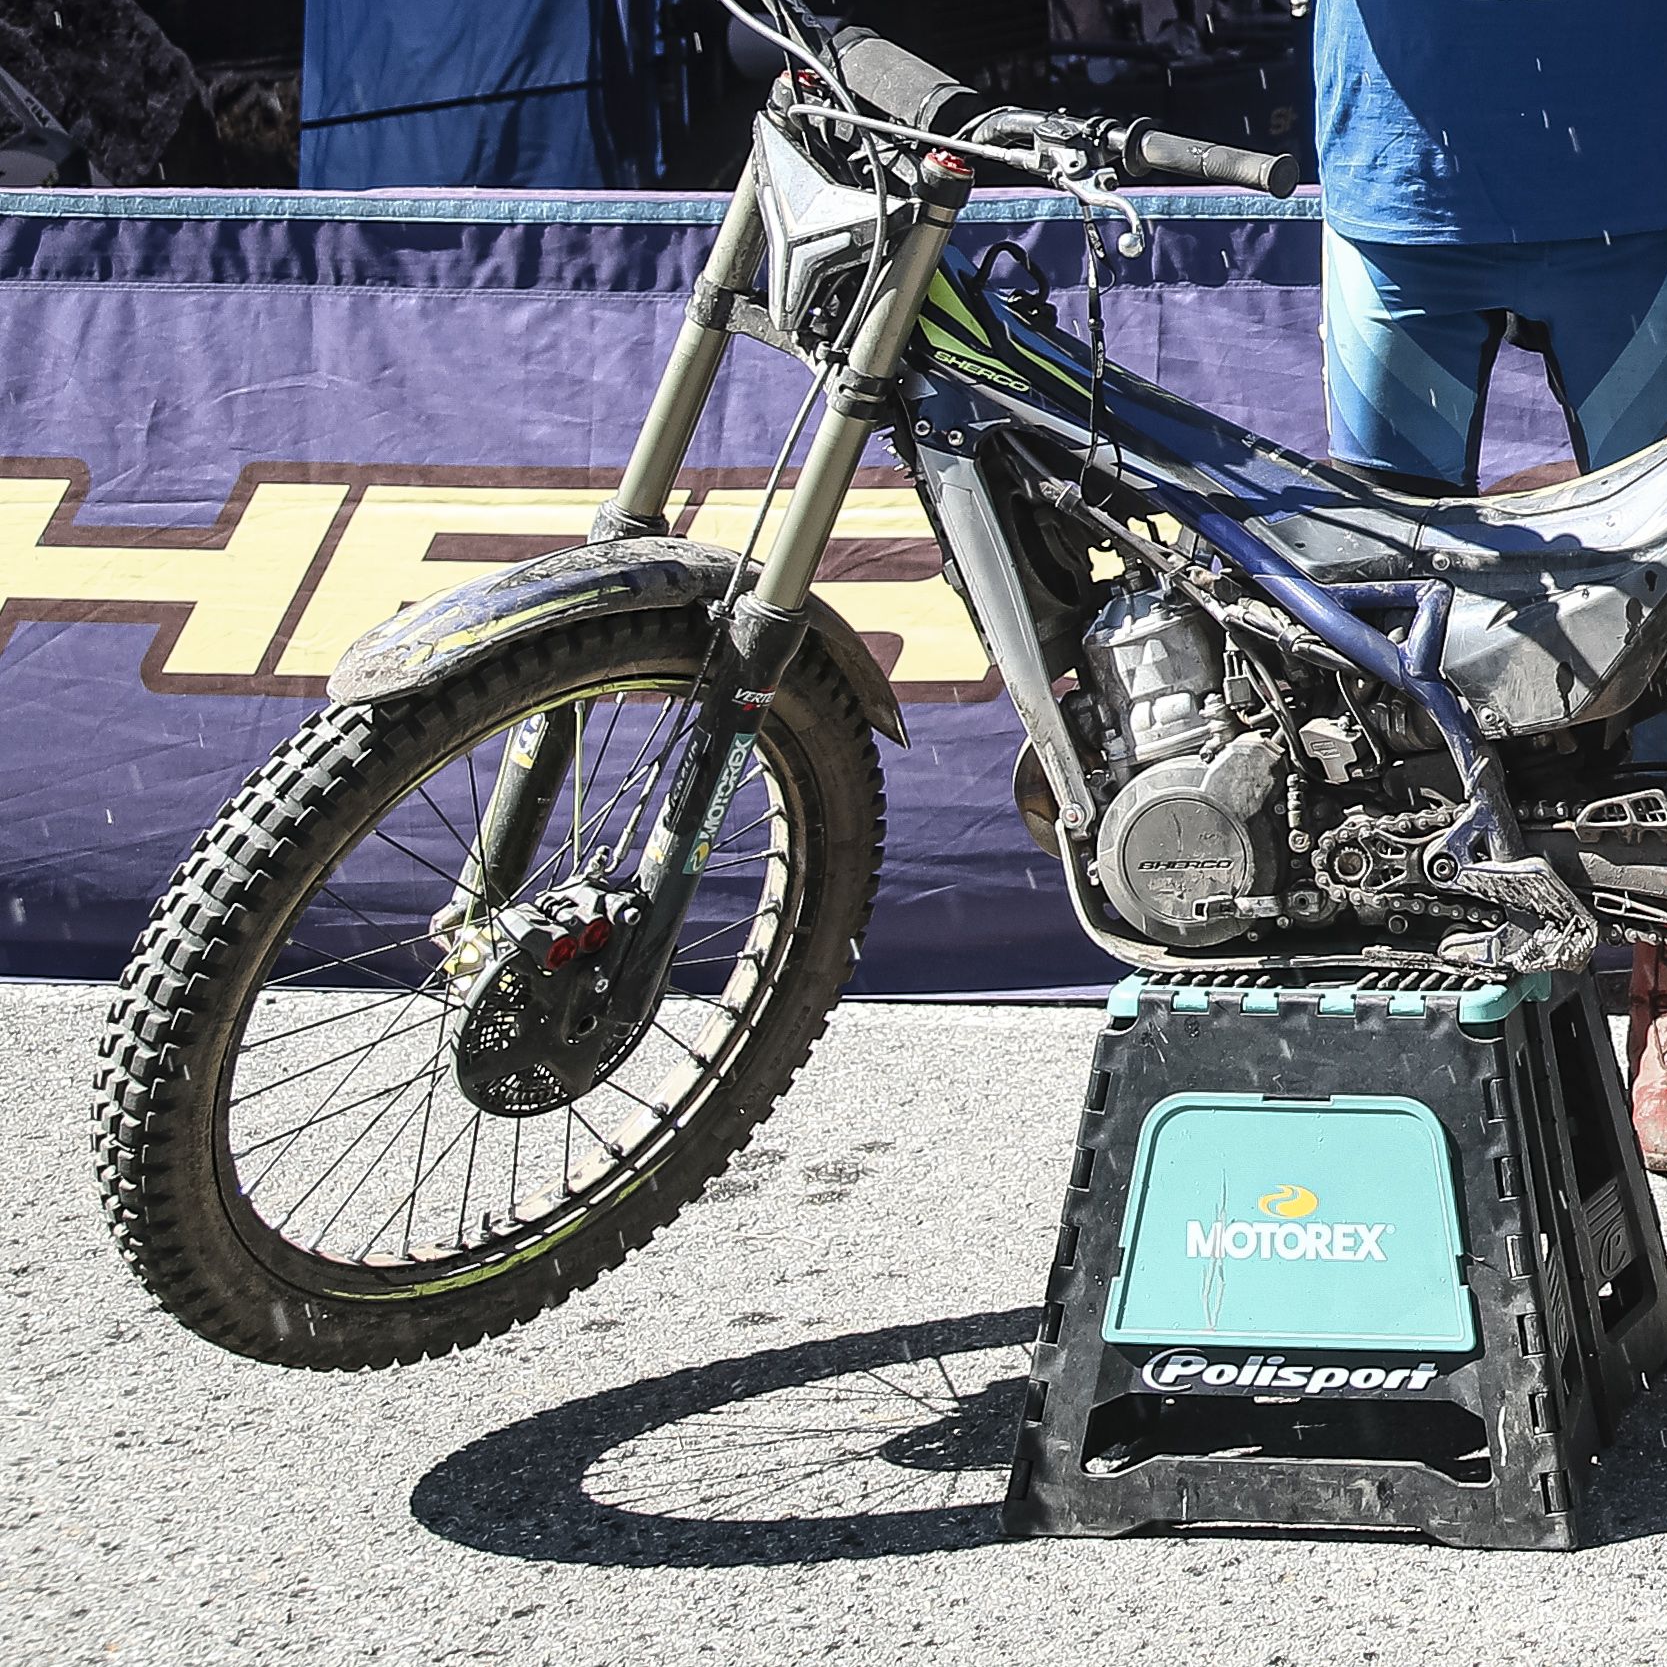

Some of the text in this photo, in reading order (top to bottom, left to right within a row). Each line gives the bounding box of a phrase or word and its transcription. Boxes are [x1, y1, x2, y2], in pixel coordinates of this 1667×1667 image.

[932, 348, 1031, 393] SHERCO
[701, 737, 752, 840] MOTOREX
[1138, 859, 1234, 871] SHERCO
[1186, 1220, 1388, 1262] MOTOREX
[1141, 1348, 1438, 1395] Polisport
